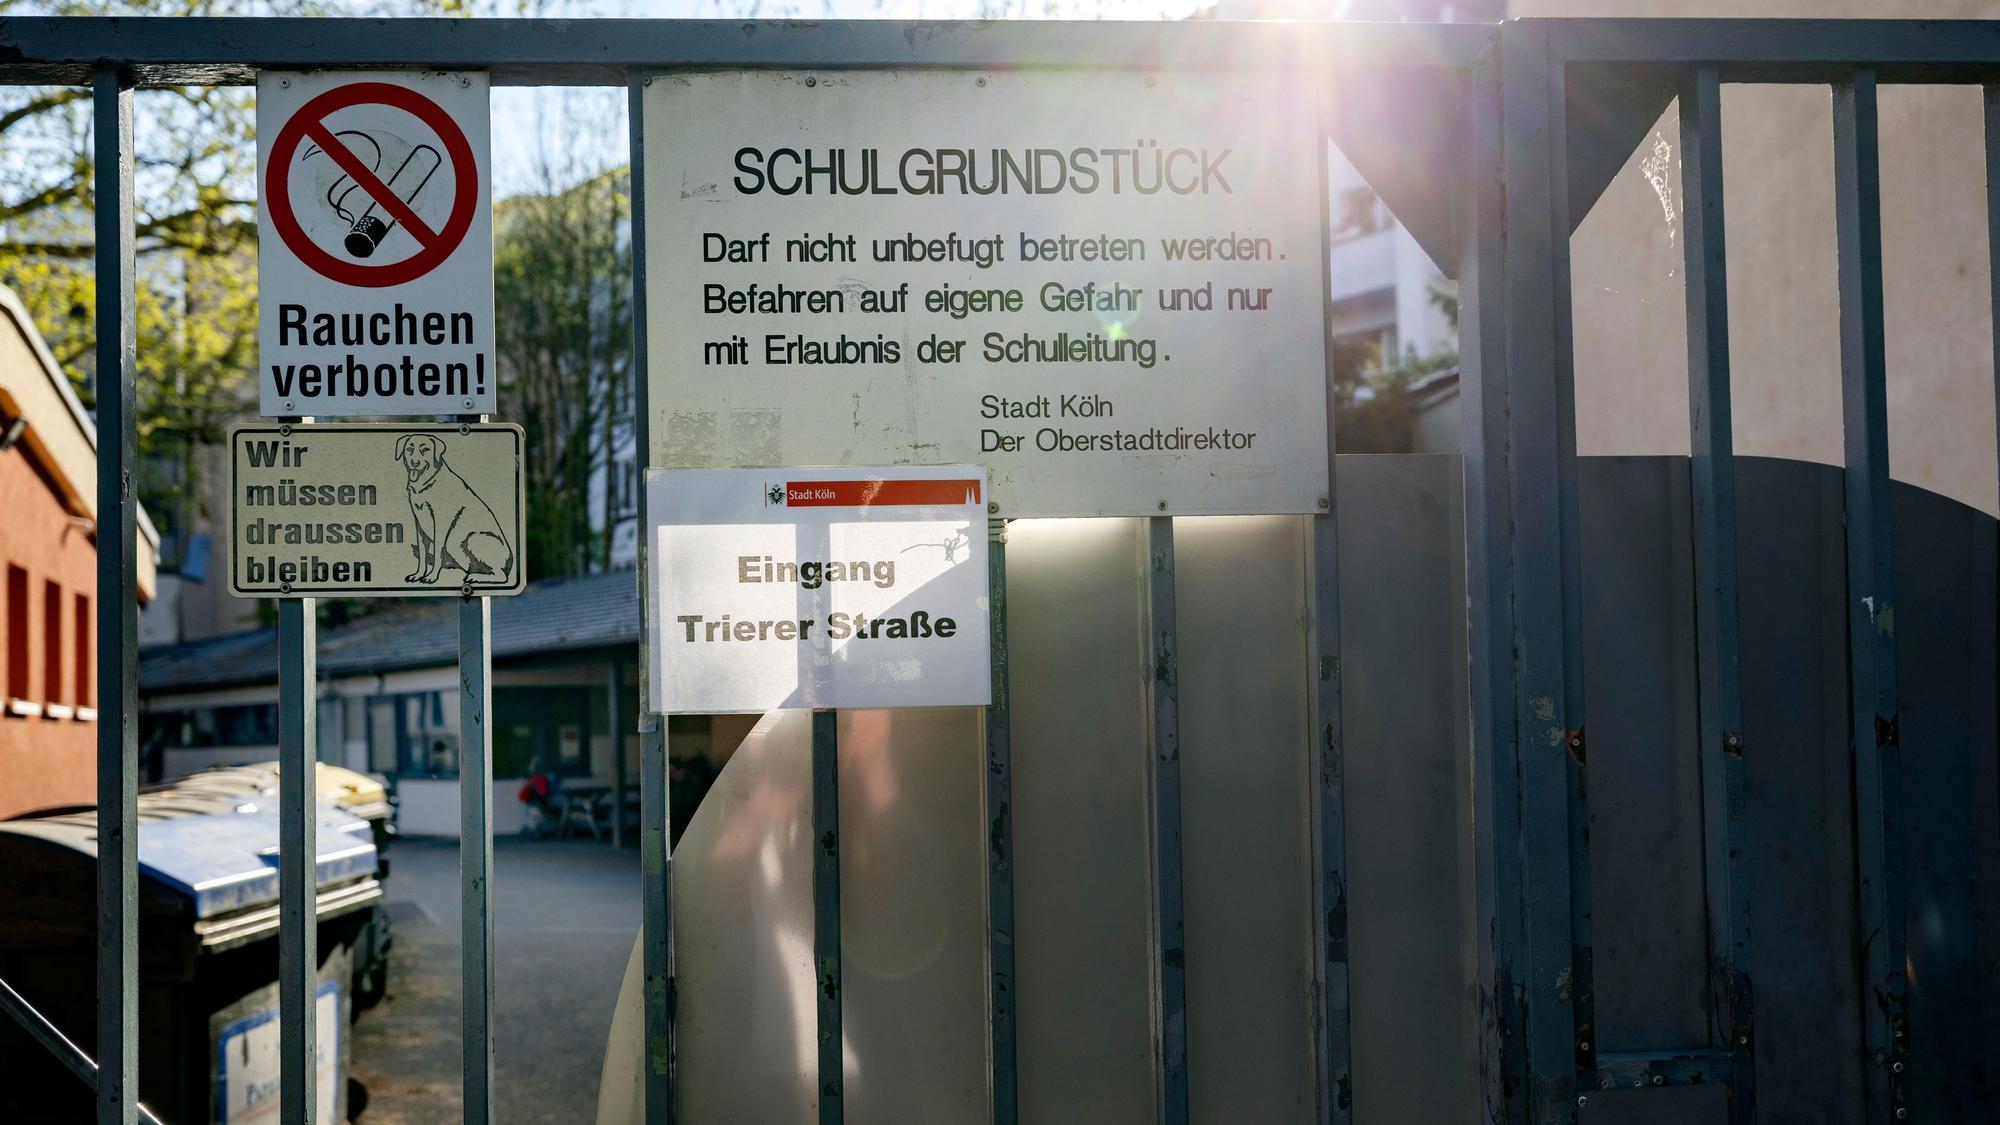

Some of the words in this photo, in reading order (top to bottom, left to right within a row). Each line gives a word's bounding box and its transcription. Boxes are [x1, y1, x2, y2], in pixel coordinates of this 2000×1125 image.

[733, 140, 1233, 196] SCHULGRUNDSTÜCK
[703, 233, 769, 262] Darf
[786, 233, 856, 262] nicht
[872, 233, 1004, 269] unbefugt
[1019, 233, 1145, 261] betreten
[1161, 233, 1286, 261] werden.
[703, 284, 844, 313] Befahren
[861, 284, 908, 312] auf
[925, 287, 1023, 319] eigene
[1040, 283, 1142, 312] Gefahr
[1159, 283, 1210, 311] und
[1228, 288, 1273, 311] nur
[279, 303, 474, 346] Rauchen
[704, 336, 748, 366] mit
[765, 335, 900, 365] Erlaubnis
[916, 335, 965, 364] der
[982, 334, 1171, 369] Schulleitung.
[271, 353, 485, 397] verboten!
[980, 394, 1051, 418] Stadt
[1060, 394, 1113, 417] Köln
[245, 440, 308, 467] Wir
[980, 429, 1025, 454] Der
[1035, 428, 1257, 452] Oberstadtdirektor
[246, 478, 377, 506] müssen
[788, 488, 814, 500] Stadt
[815, 488, 836, 500] Köln
[246, 518, 404, 545] draussen
[246, 557, 372, 583] bleiben
[738, 555, 896, 590] Eingang
[677, 613, 814, 643] Trierer
[827, 610, 957, 640] Straße
